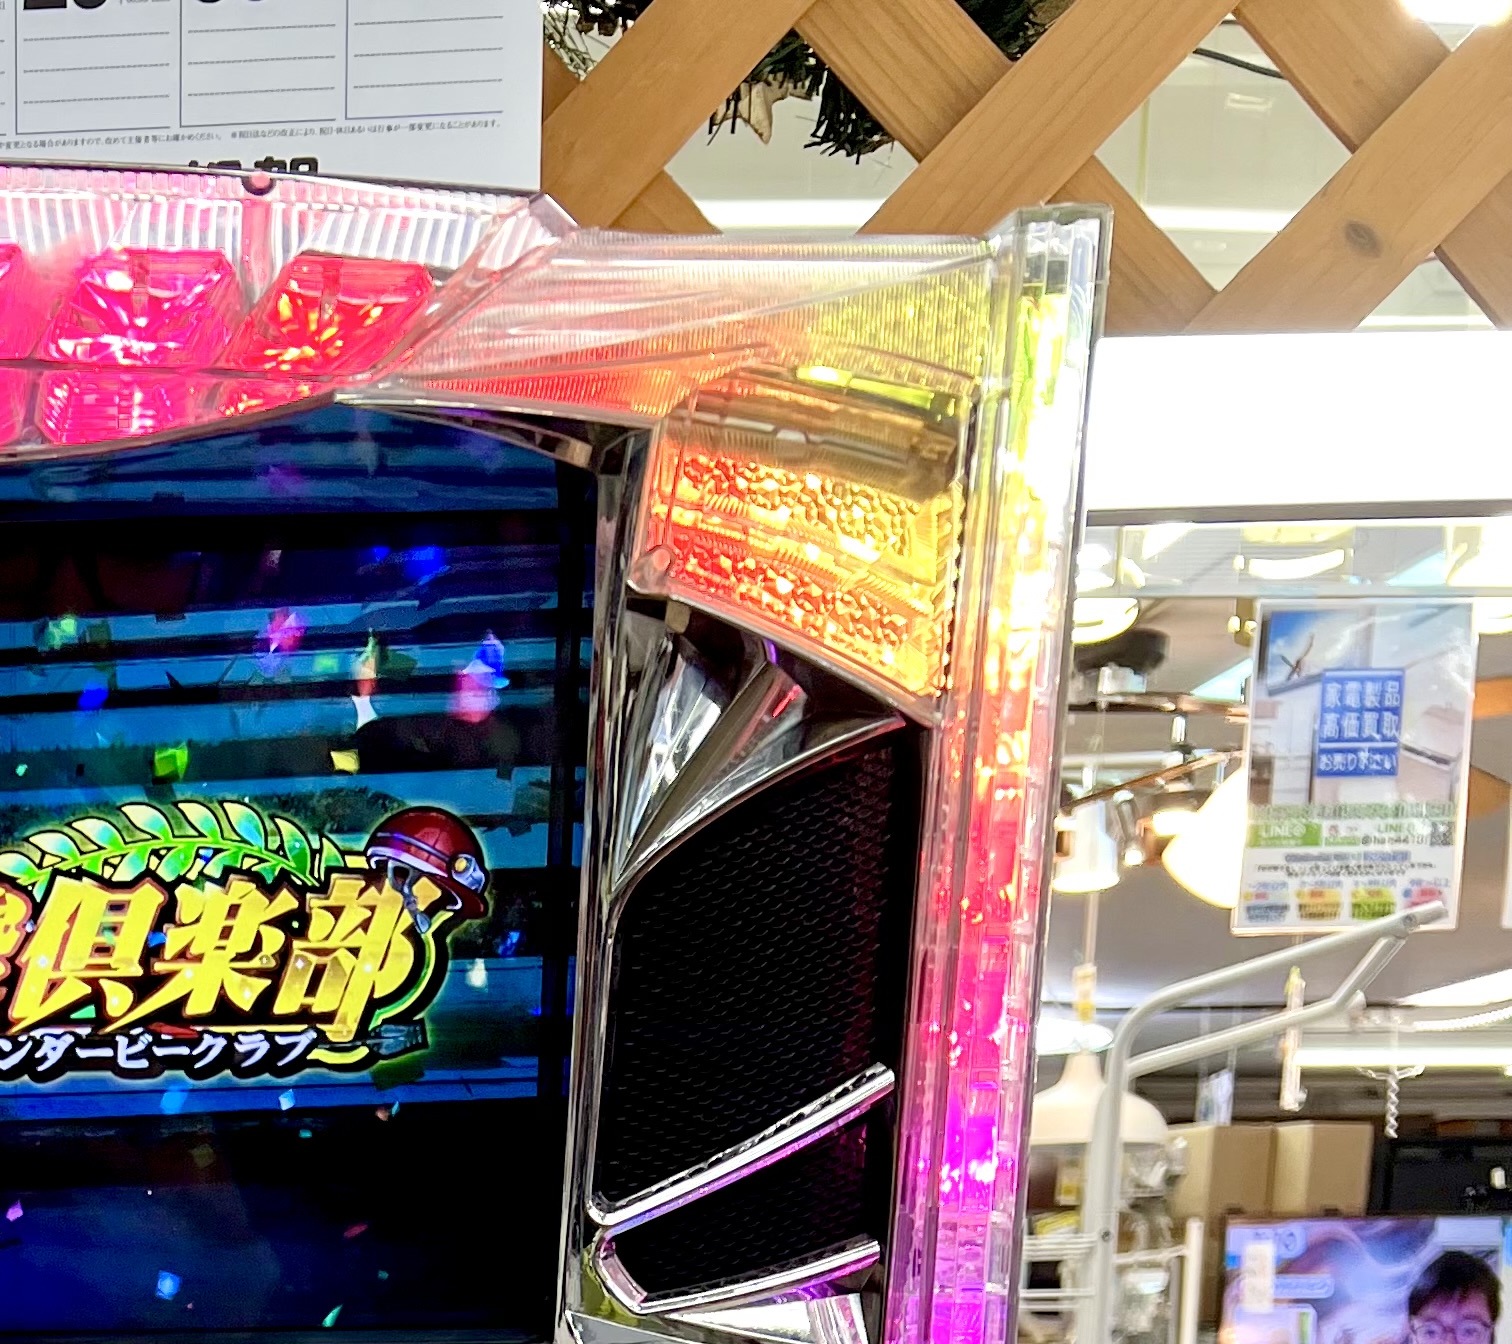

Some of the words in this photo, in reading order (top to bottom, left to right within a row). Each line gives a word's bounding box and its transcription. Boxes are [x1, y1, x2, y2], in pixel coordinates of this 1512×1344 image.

[1324, 680, 1402, 708] 家電製品
[1321, 711, 1400, 739] 高価買取
